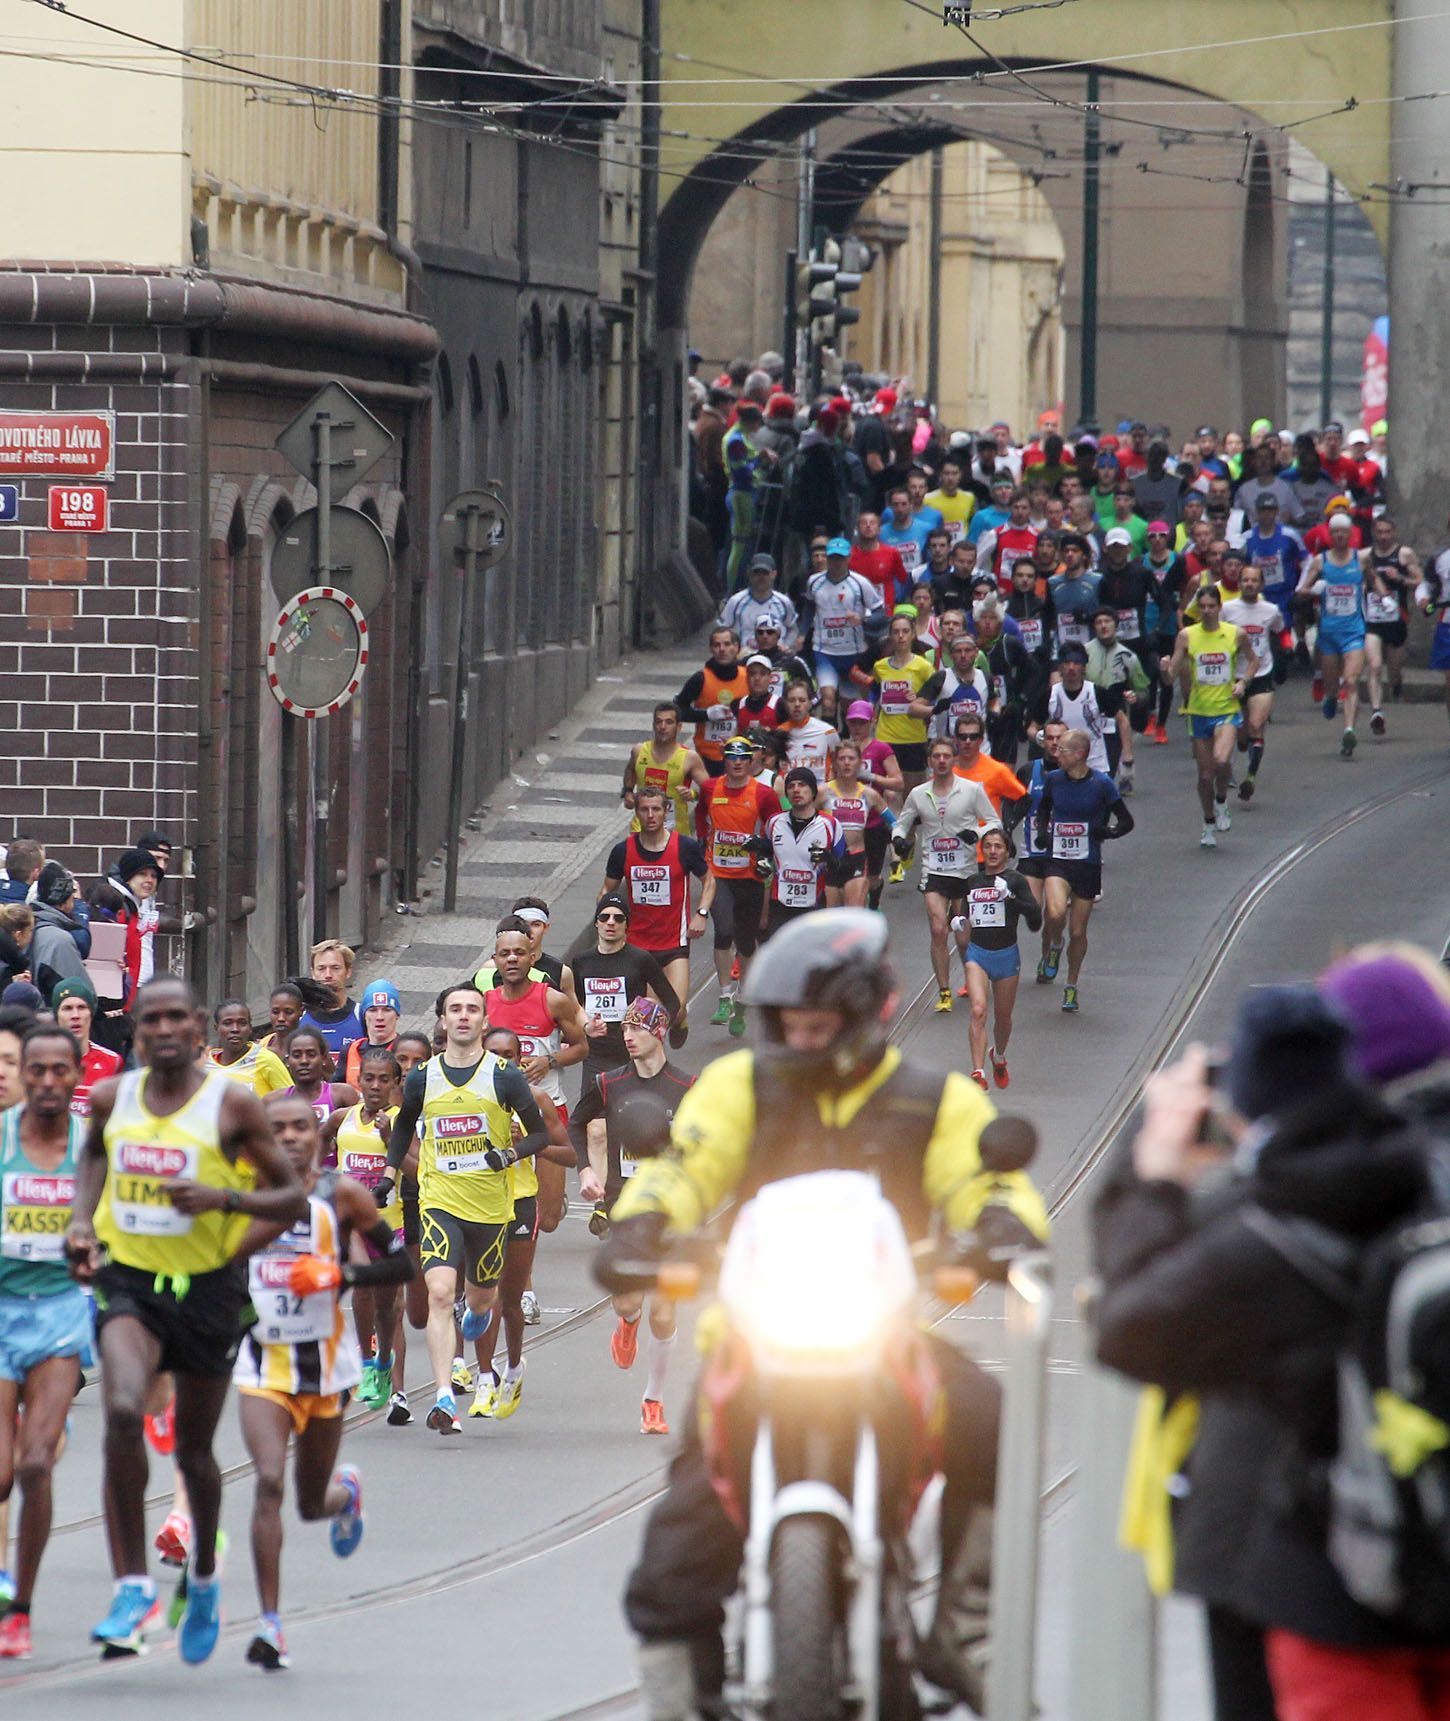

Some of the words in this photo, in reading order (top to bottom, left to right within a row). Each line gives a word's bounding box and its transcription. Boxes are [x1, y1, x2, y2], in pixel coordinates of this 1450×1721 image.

[65, 425, 102, 448] LÁVKA
[91, 453, 96, 464] 1
[61, 492, 94, 511] 198
[837, 801, 861, 810] Hervis
[1061, 838, 1079, 848] 391
[937, 852, 955, 862] 316
[637, 868, 664, 879] Hervis
[785, 870, 812, 881] Hervis
[641, 882, 660, 893] 347
[787, 884, 808, 895] 283
[982, 903, 996, 915] 25
[590, 980, 619, 992] Hervis
[595, 995, 616, 1009] 267
[440, 1118, 480, 1133] Hervis
[123, 1145, 183, 1174] Hervis
[350, 1154, 386, 1171] Hervis
[16, 1180, 76, 1204] Hervis
[116, 1180, 171, 1207] LIM
[276, 1294, 304, 1317] 32
